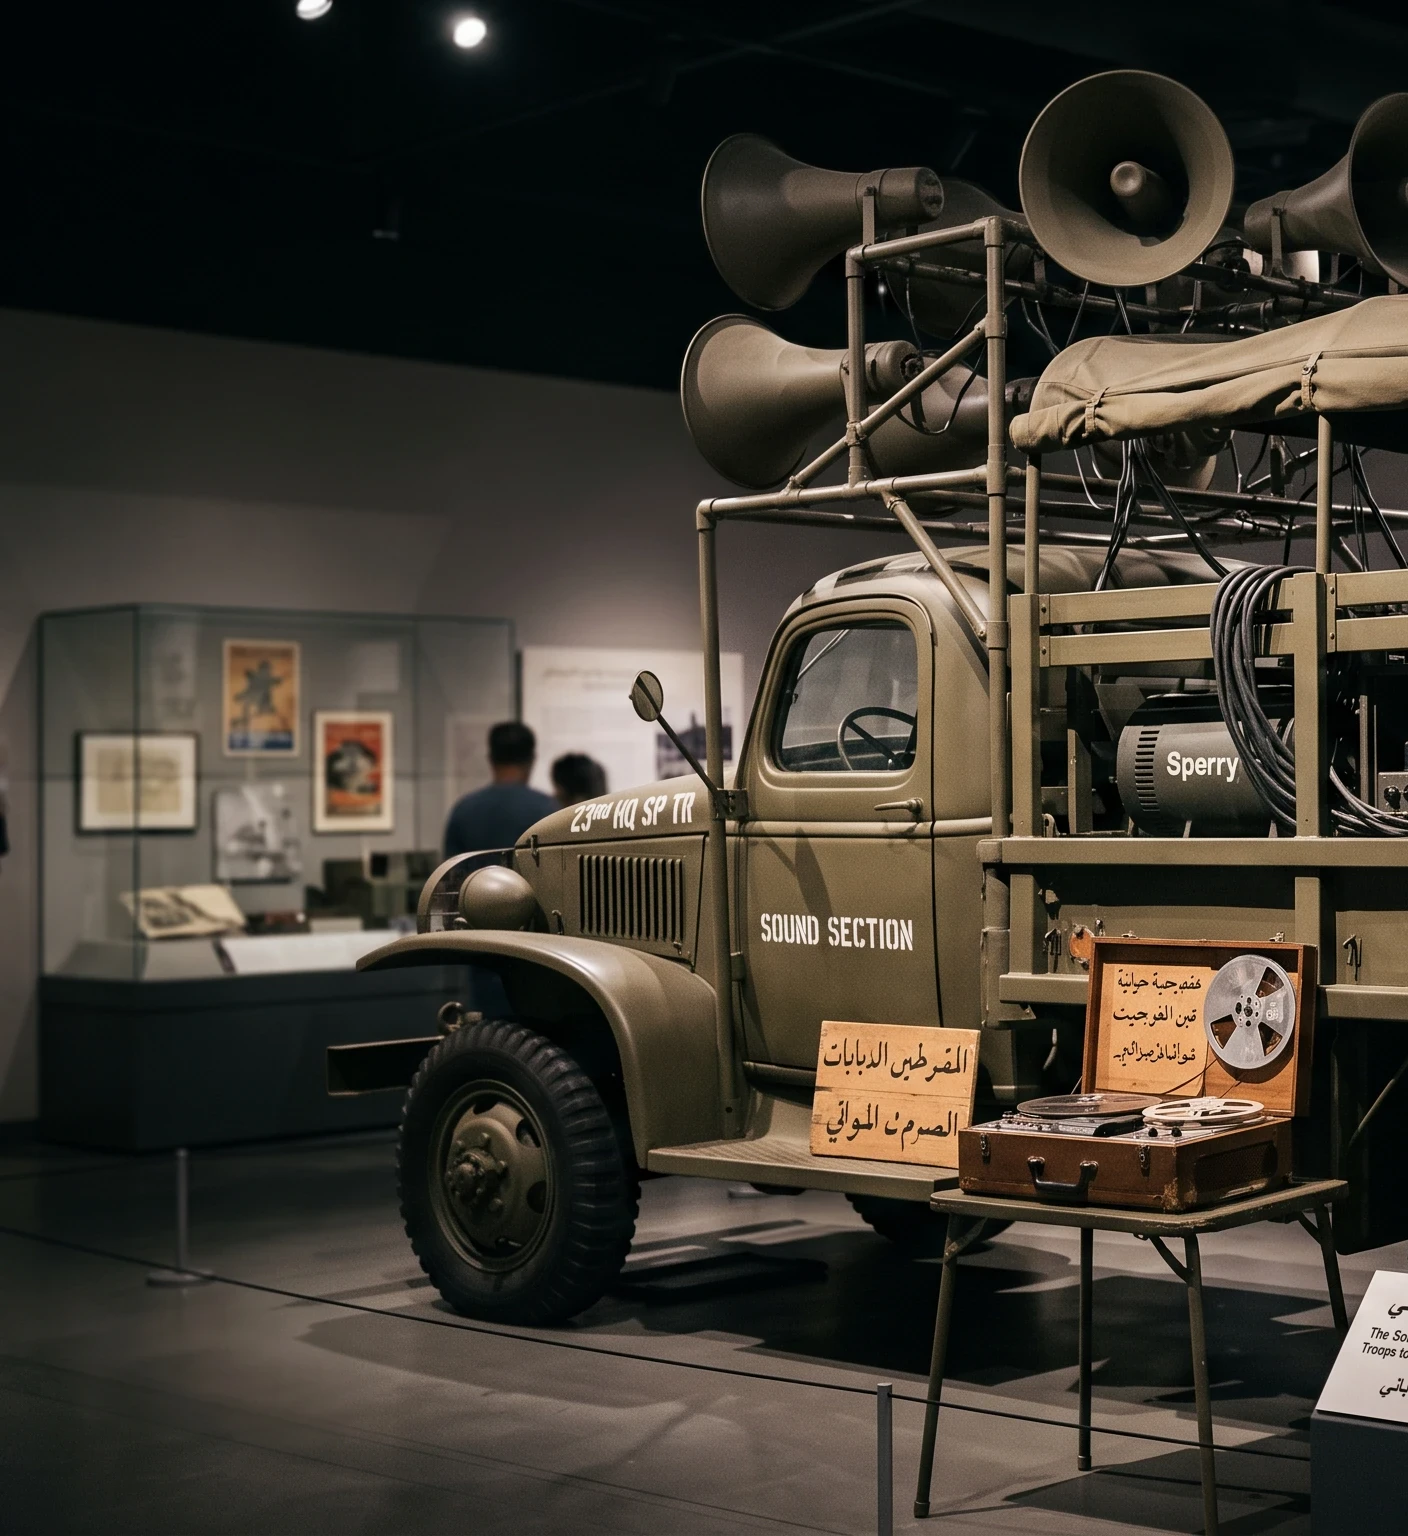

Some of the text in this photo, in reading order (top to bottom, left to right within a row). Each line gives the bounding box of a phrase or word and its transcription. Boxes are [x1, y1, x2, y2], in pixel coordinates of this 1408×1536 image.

[1166, 751, 1239, 783] Sperry
[614, 798, 637, 831] HQ
[641, 794, 669, 827] SP
[673, 791, 696, 825] TR
[759, 912, 914, 951] SOUND SECTION
[1371, 1327, 1389, 1339] The
[1363, 1342, 1396, 1359] Troops
